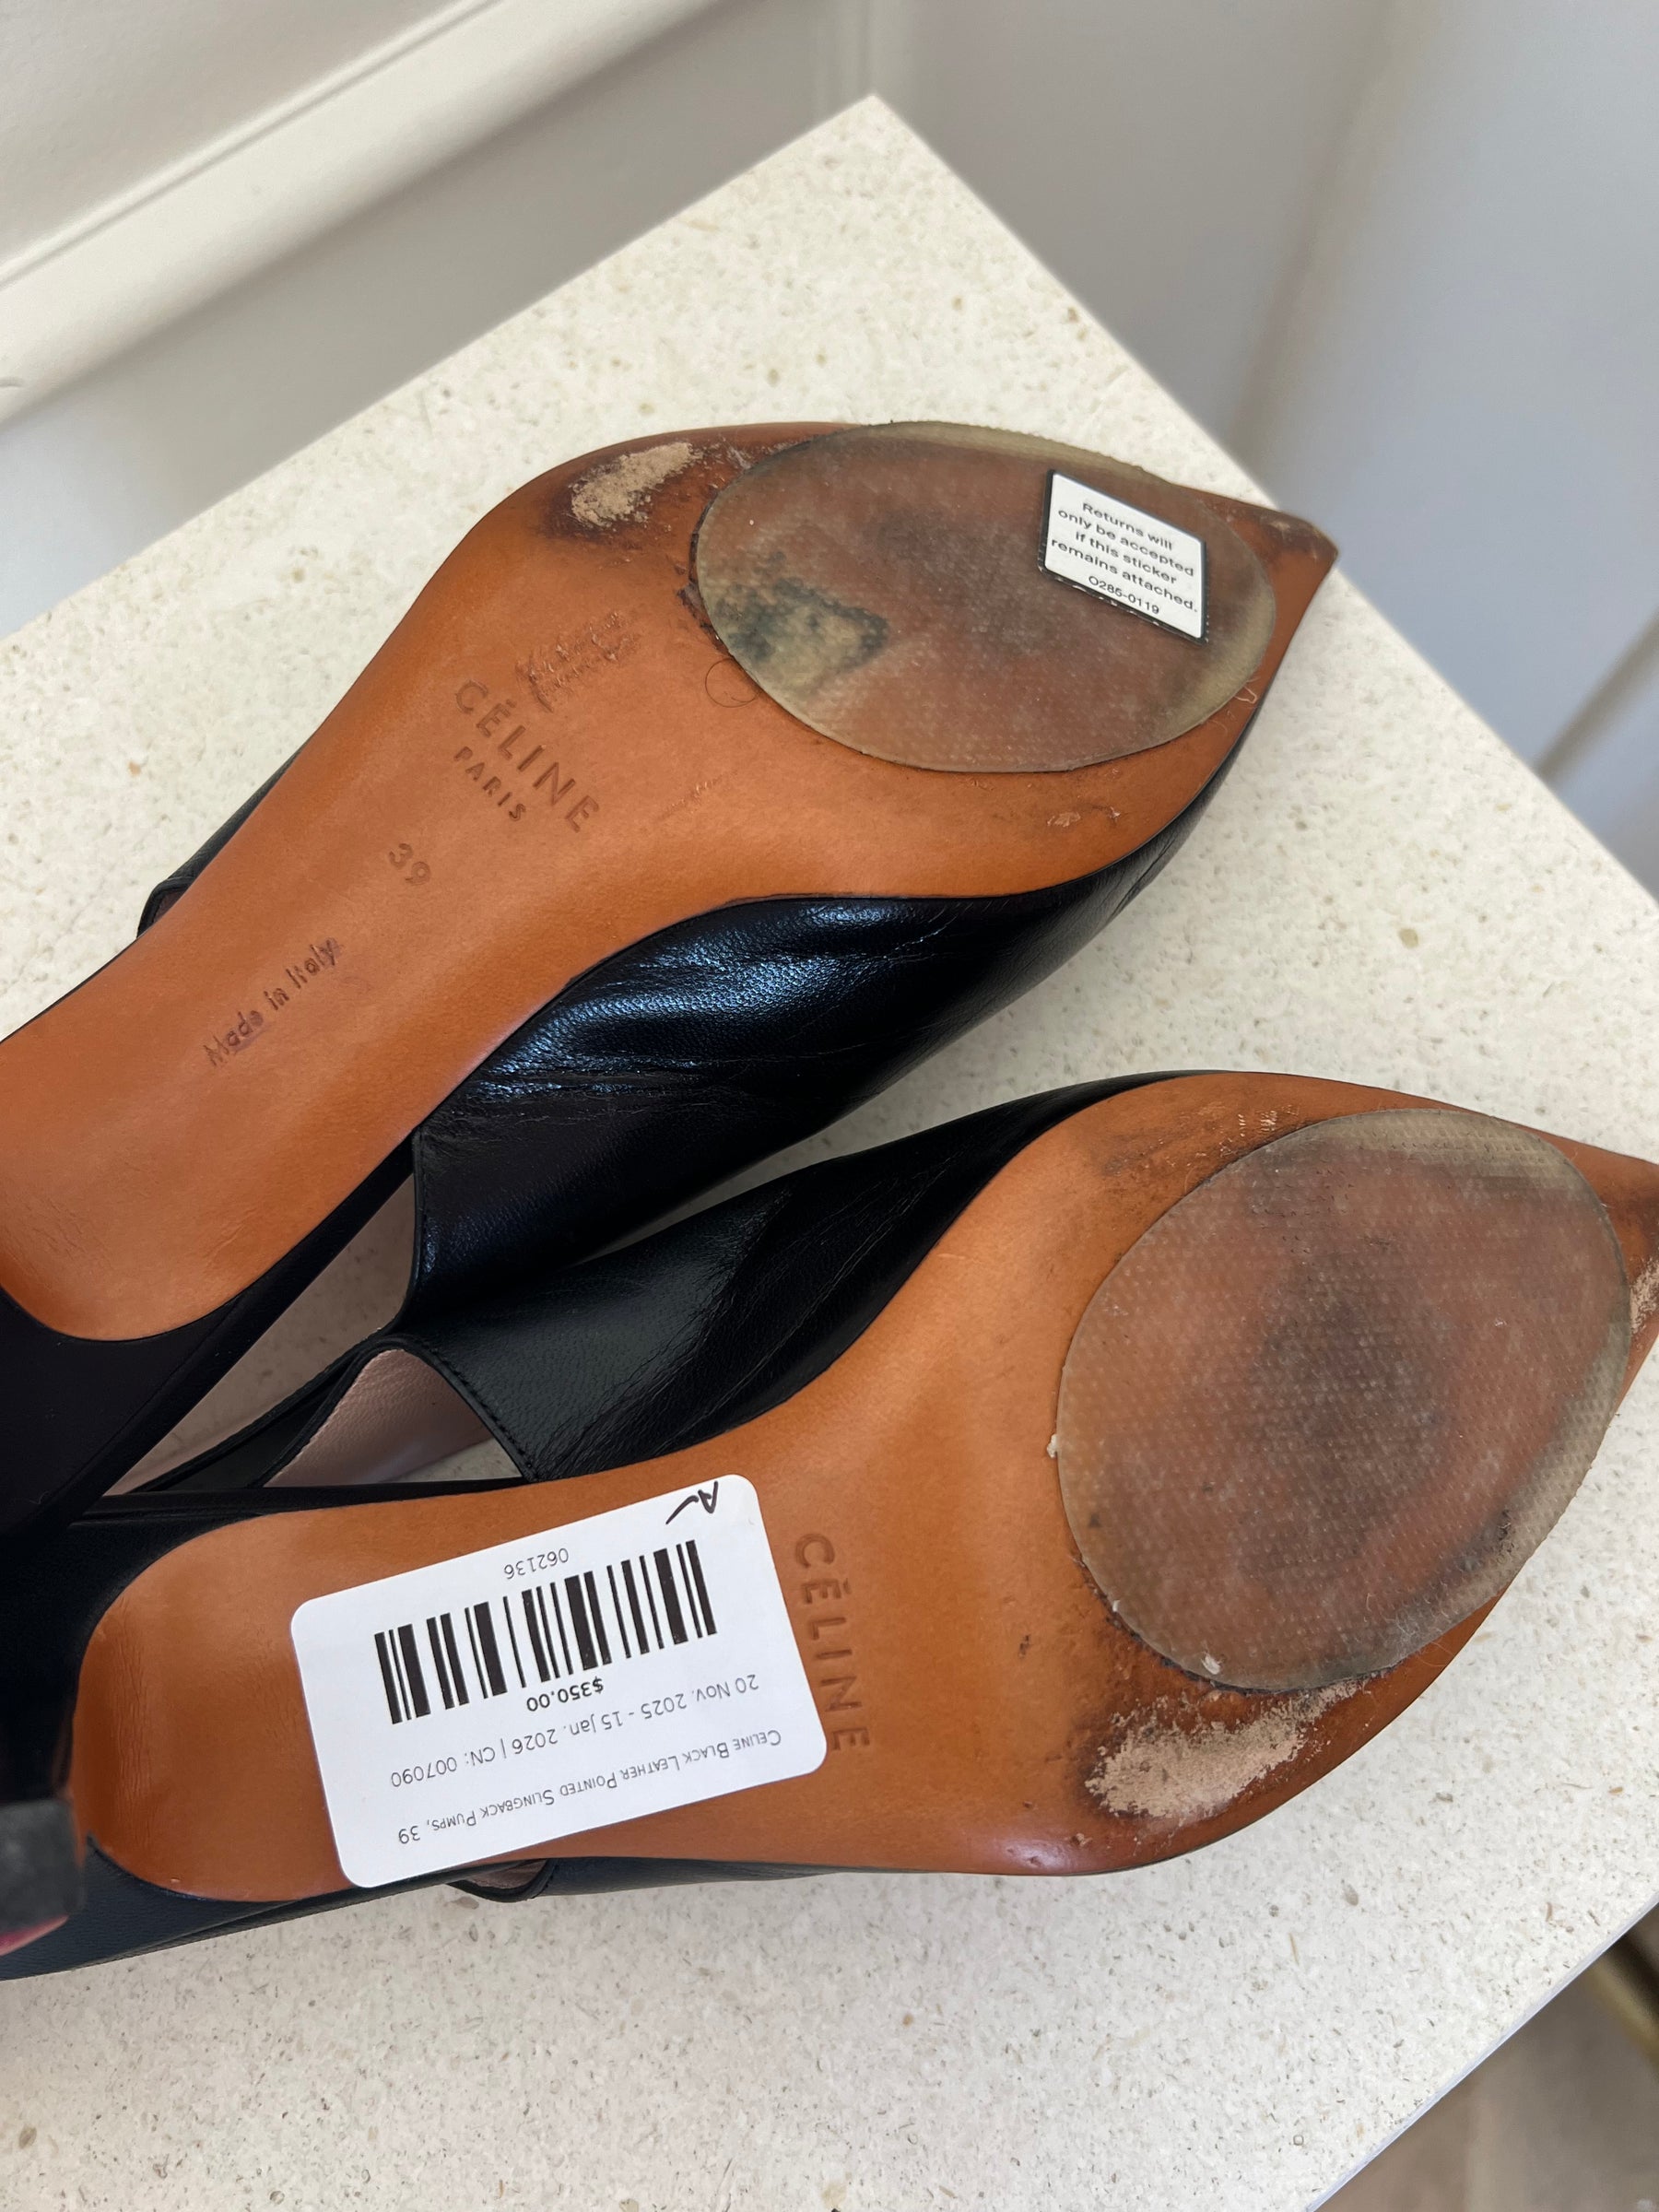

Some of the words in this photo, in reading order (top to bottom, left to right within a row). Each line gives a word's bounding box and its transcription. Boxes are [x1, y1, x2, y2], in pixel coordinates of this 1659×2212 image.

[1082, 502, 1144, 537] Returns
[1147, 533, 1172, 550] will
[1058, 510, 1091, 529] only
[1096, 524, 1116, 540] be
[1120, 536, 1194, 577] accepted
[1076, 531, 1086, 542] if
[1089, 536, 1119, 558] this
[1124, 554, 1177, 584] sticker
[1051, 539, 1118, 574] remains
[1122, 571, 1198, 613] attached.
[453, 746, 526, 820] PARIS
[388, 842, 431, 885] 39
[203, 1010, 264, 1067] Made
[264, 987, 290, 1011] in
[286, 936, 341, 990] Italy
[503, 1547, 570, 1580] 062136
[795, 1533, 870, 1751] CÉLINE
[525, 1676, 605, 1712] $350.00
[690, 1681, 731, 1703] Nov.
[735, 1674, 759, 1694] 20
[600, 1711, 623, 1731] 15
[641, 1693, 688, 1720] 2025
[562, 1713, 596, 1736] Jan.
[464, 1747, 496, 1768] CN:
[512, 1728, 559, 1755] 2026
[390, 1757, 458, 1788] 007090
[397, 1825, 421, 1845] 39
